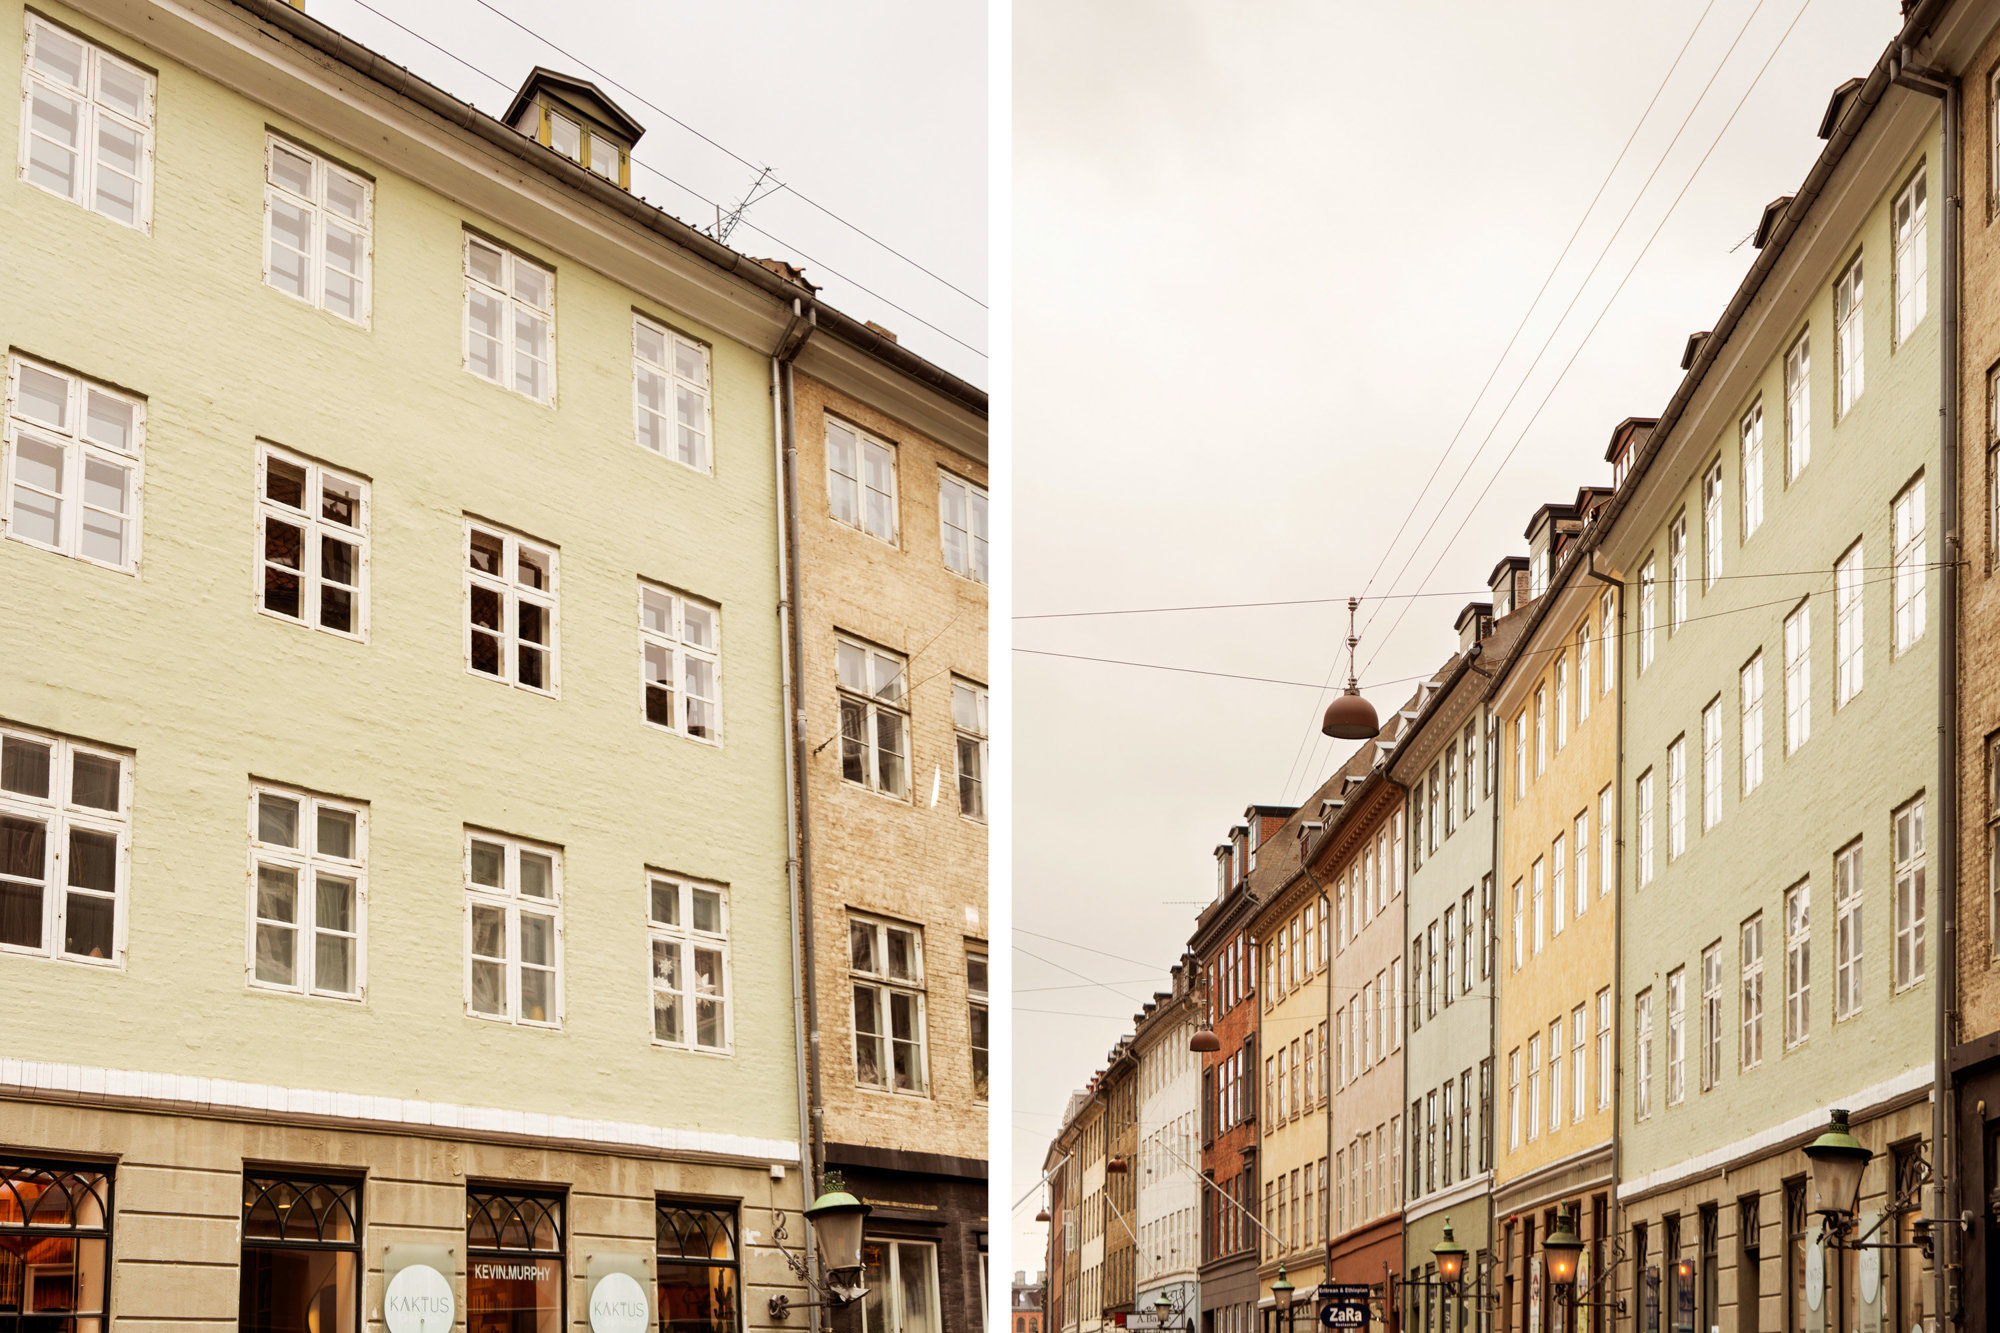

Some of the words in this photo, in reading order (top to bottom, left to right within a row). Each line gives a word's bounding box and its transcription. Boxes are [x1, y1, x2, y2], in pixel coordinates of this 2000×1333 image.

[475, 1264, 550, 1281] KEVIN.MURPHY
[390, 1296, 450, 1313] KAKTUS
[594, 1301, 645, 1318] KAKTUS
[1329, 1307, 1363, 1322] ZaRa
